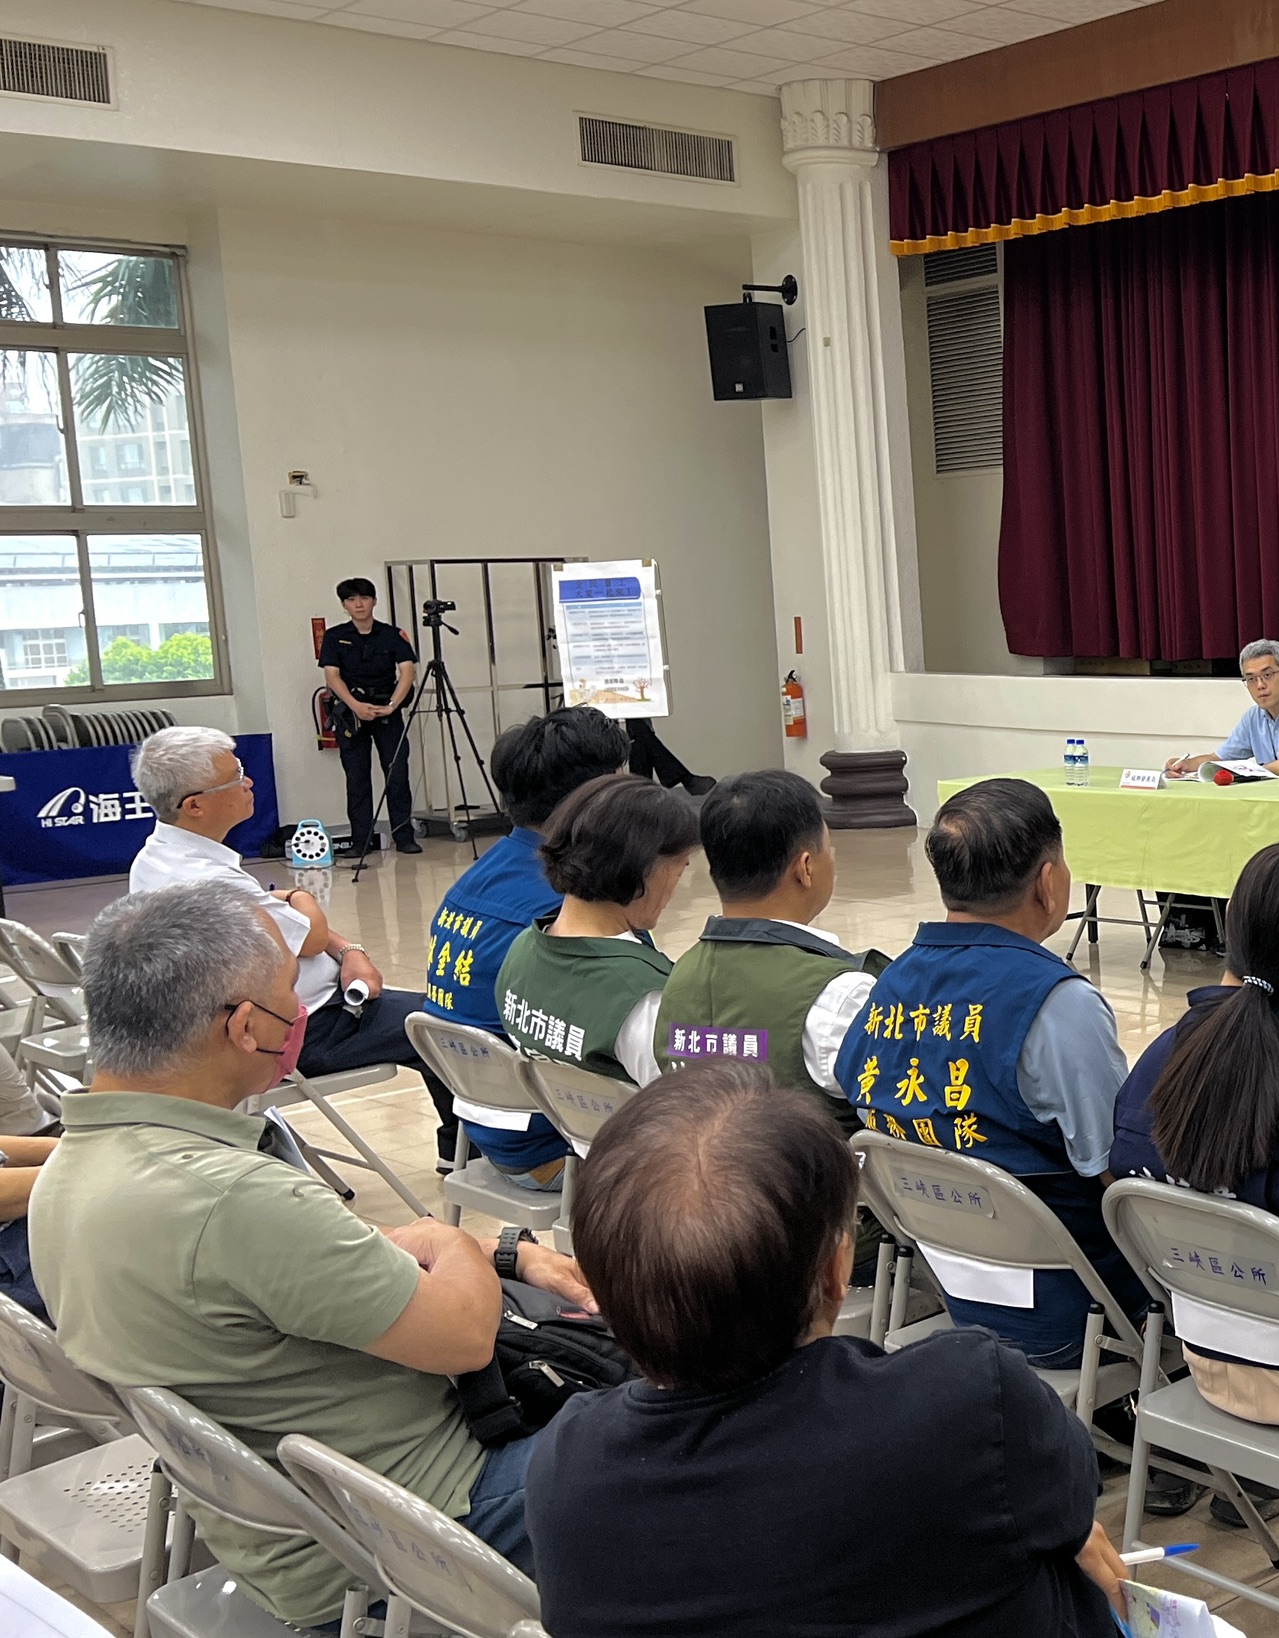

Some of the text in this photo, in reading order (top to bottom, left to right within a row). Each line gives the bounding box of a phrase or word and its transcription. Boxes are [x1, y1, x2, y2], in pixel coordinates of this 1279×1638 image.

[41, 815, 85, 828] HI STAR
[502, 988, 586, 1062] 新北市議員
[863, 1002, 984, 1043] 新北市議員
[673, 1027, 759, 1058] 新北市議員
[901, 1176, 983, 1209] 三峽區公所
[1170, 1246, 1269, 1287] 三峽區公所
